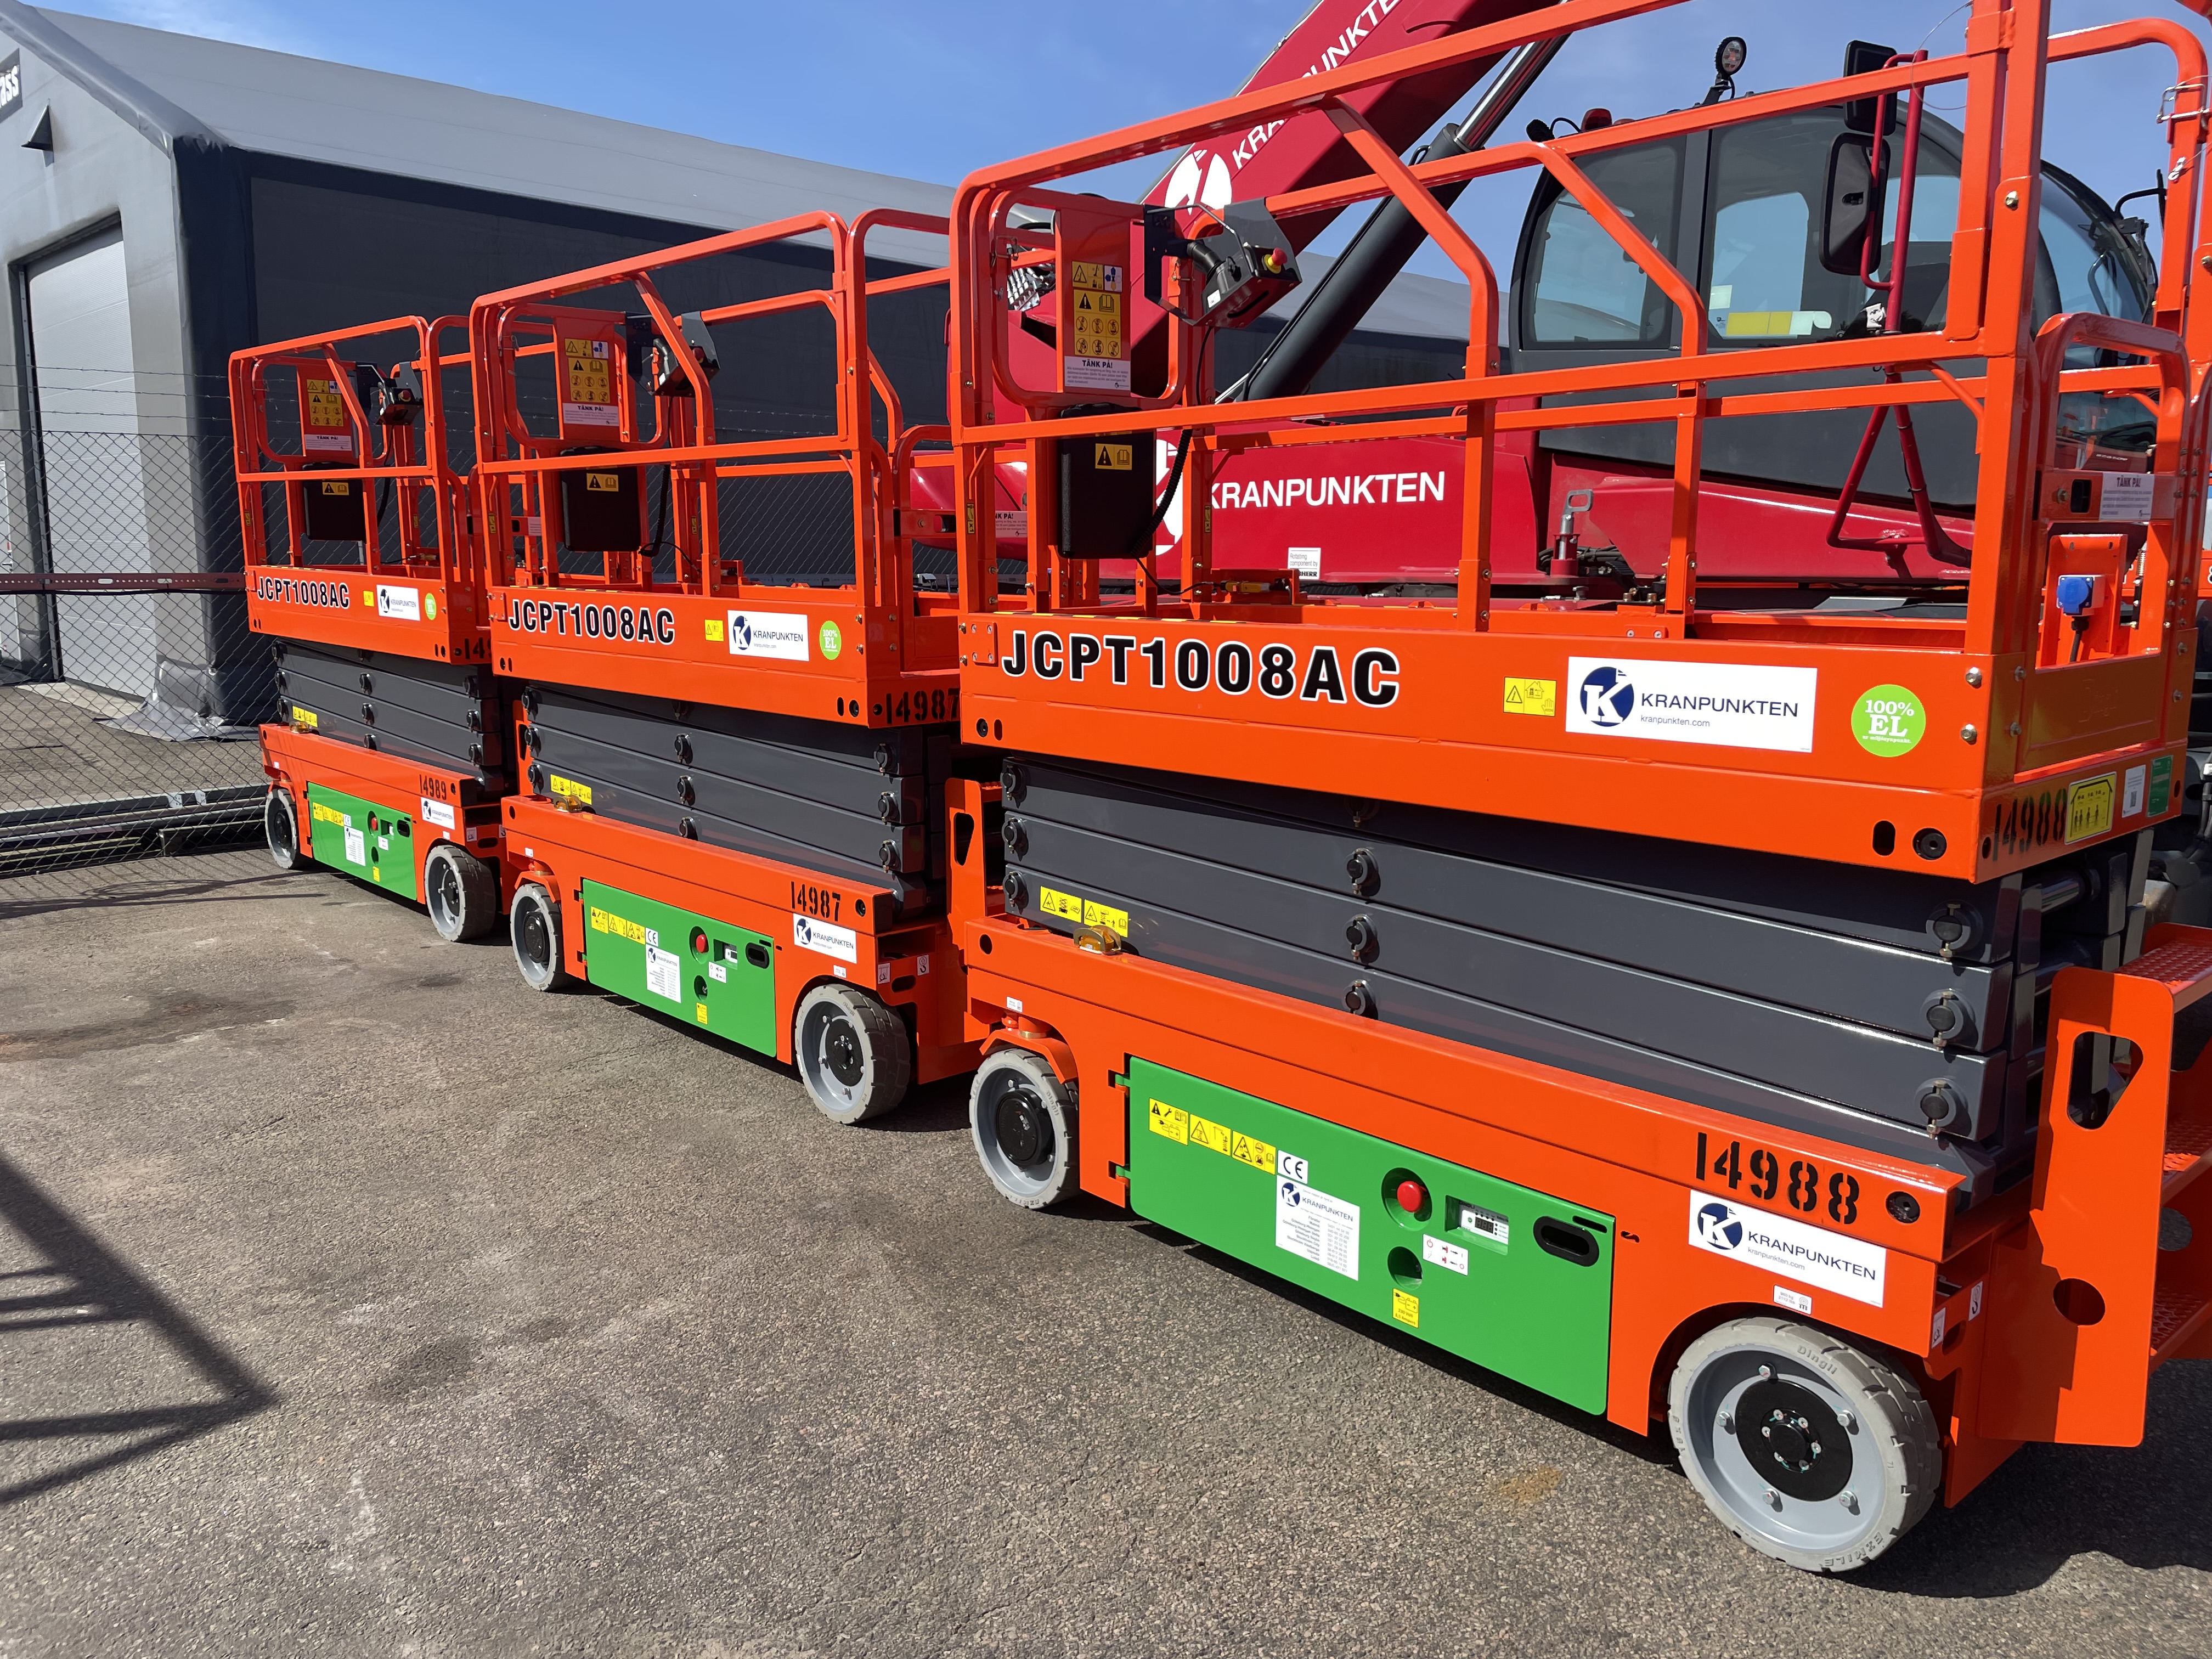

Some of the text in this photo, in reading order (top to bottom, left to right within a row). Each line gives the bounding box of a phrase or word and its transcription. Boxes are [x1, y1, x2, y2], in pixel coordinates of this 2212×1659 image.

[1082, 359, 1113, 368] TÄNK PÅ!
[257, 577, 349, 609] JCPT1008AC
[507, 598, 675, 645] JCPT1008AC
[823, 629, 837, 638] 100%
[753, 630, 803, 642] KRANPUNKTEN
[825, 637, 837, 648] EL
[1001, 629, 1400, 708] JCPT1008AC
[886, 688, 960, 724] 14987
[1641, 693, 1798, 717] KRANPUNKTEN
[1865, 699, 1915, 716] 100%
[1640, 715, 1710, 727] kranpunkten.com
[1868, 714, 1908, 737] EL
[420, 774, 447, 800] 14989
[1993, 788, 2067, 861] 14988
[791, 881, 840, 922] 14987
[648, 930, 656, 944] CE
[813, 932, 854, 949] KRANPUNKTEN
[1283, 1156, 1303, 1179] CE
[1696, 1132, 1859, 1224] 14988
[1302, 1196, 1353, 1222] KRANPUNKTEN
[1748, 1231, 1876, 1280] KRANPUNKTEN
[1748, 1247, 1805, 1271] kranpunkten.com
